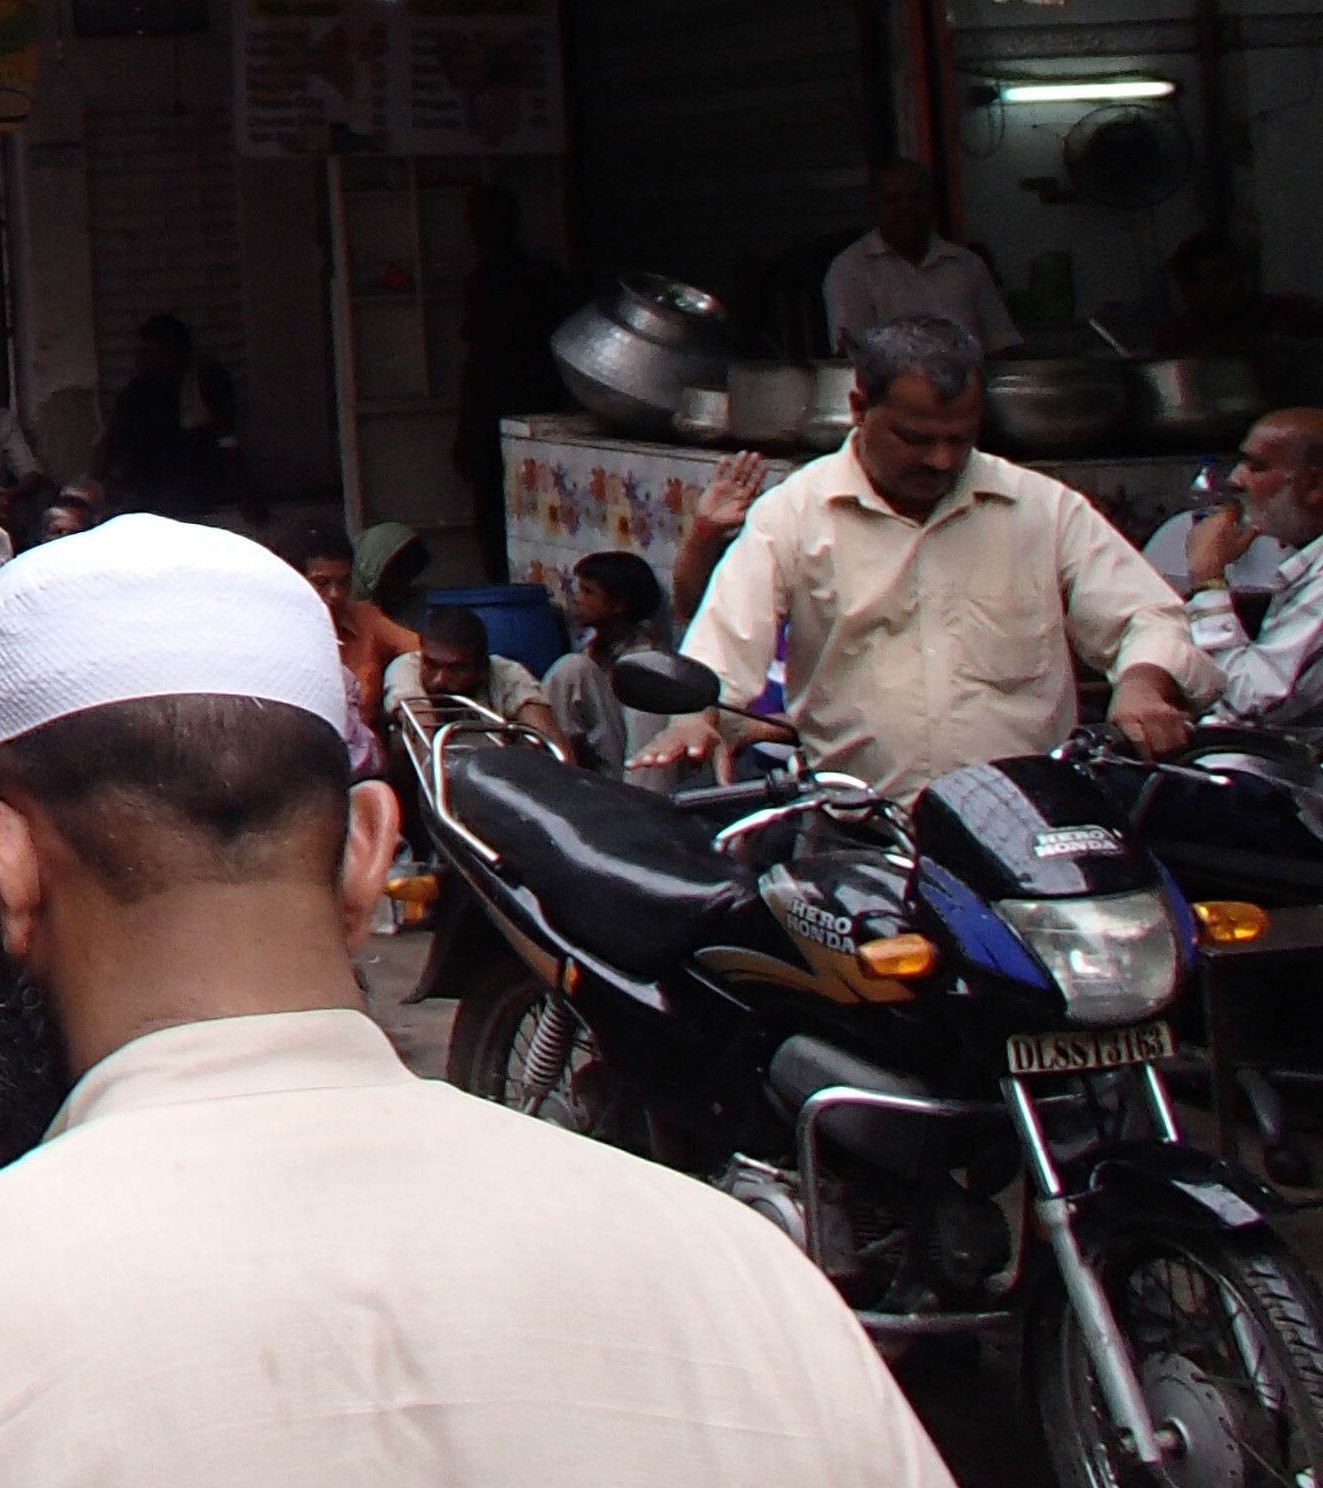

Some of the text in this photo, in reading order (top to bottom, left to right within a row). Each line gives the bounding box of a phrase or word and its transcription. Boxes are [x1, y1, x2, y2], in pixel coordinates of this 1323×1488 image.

[1036, 839, 1120, 857] HONDA
[1038, 829, 1106, 844] HERO
[791, 897, 852, 934] HERO
[786, 915, 857, 954] HONDA
